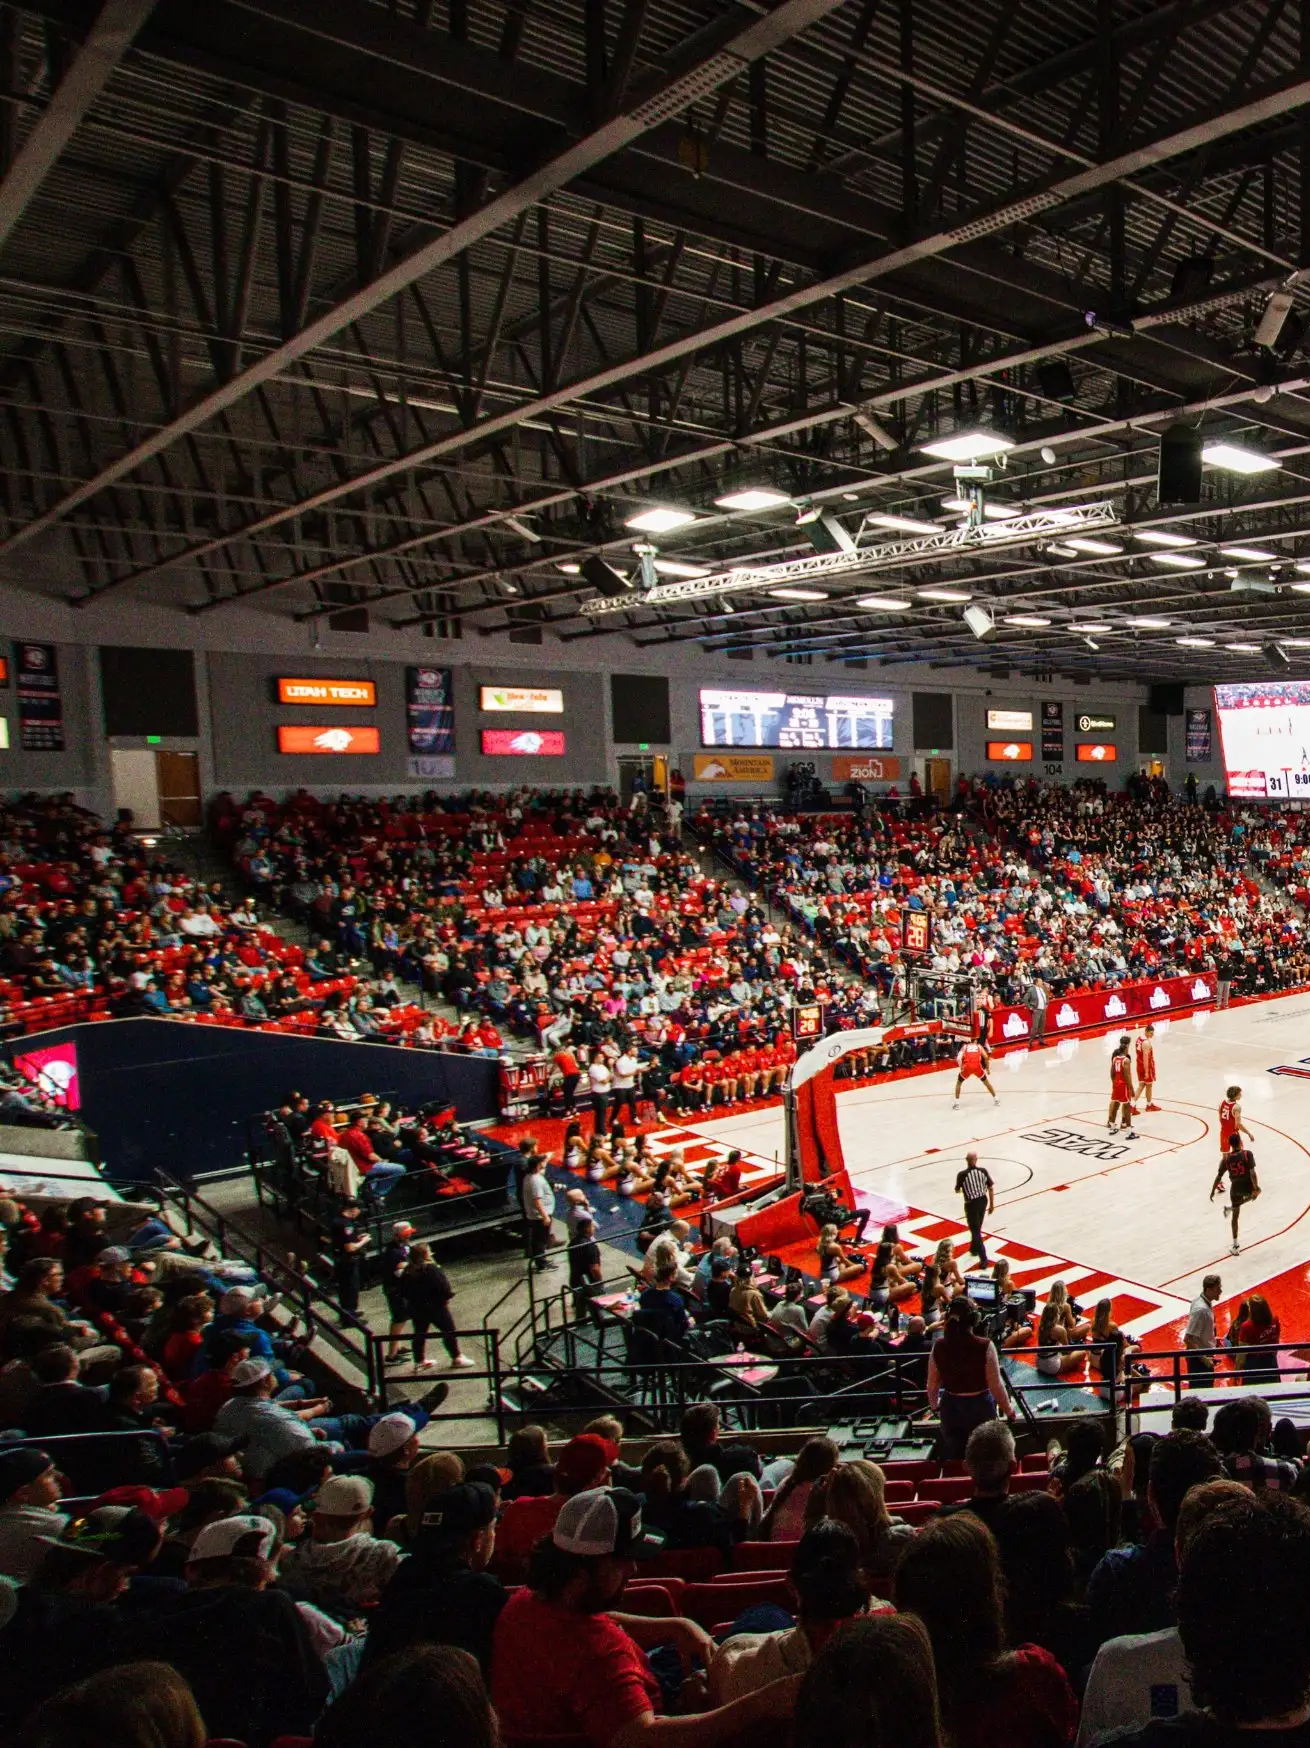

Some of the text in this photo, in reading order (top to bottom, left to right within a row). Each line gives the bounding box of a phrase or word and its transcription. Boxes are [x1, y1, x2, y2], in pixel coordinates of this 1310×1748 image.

[285, 685, 369, 699] UTAH TECH
[850, 768, 878, 779] ZION
[1043, 764, 1062, 775] 104
[1270, 777, 1282, 791] 31
[907, 925, 924, 948] 28
[800, 1019, 816, 1033] 28
[1221, 1108, 1230, 1121] 21
[1018, 1128, 1131, 1161] WAC
